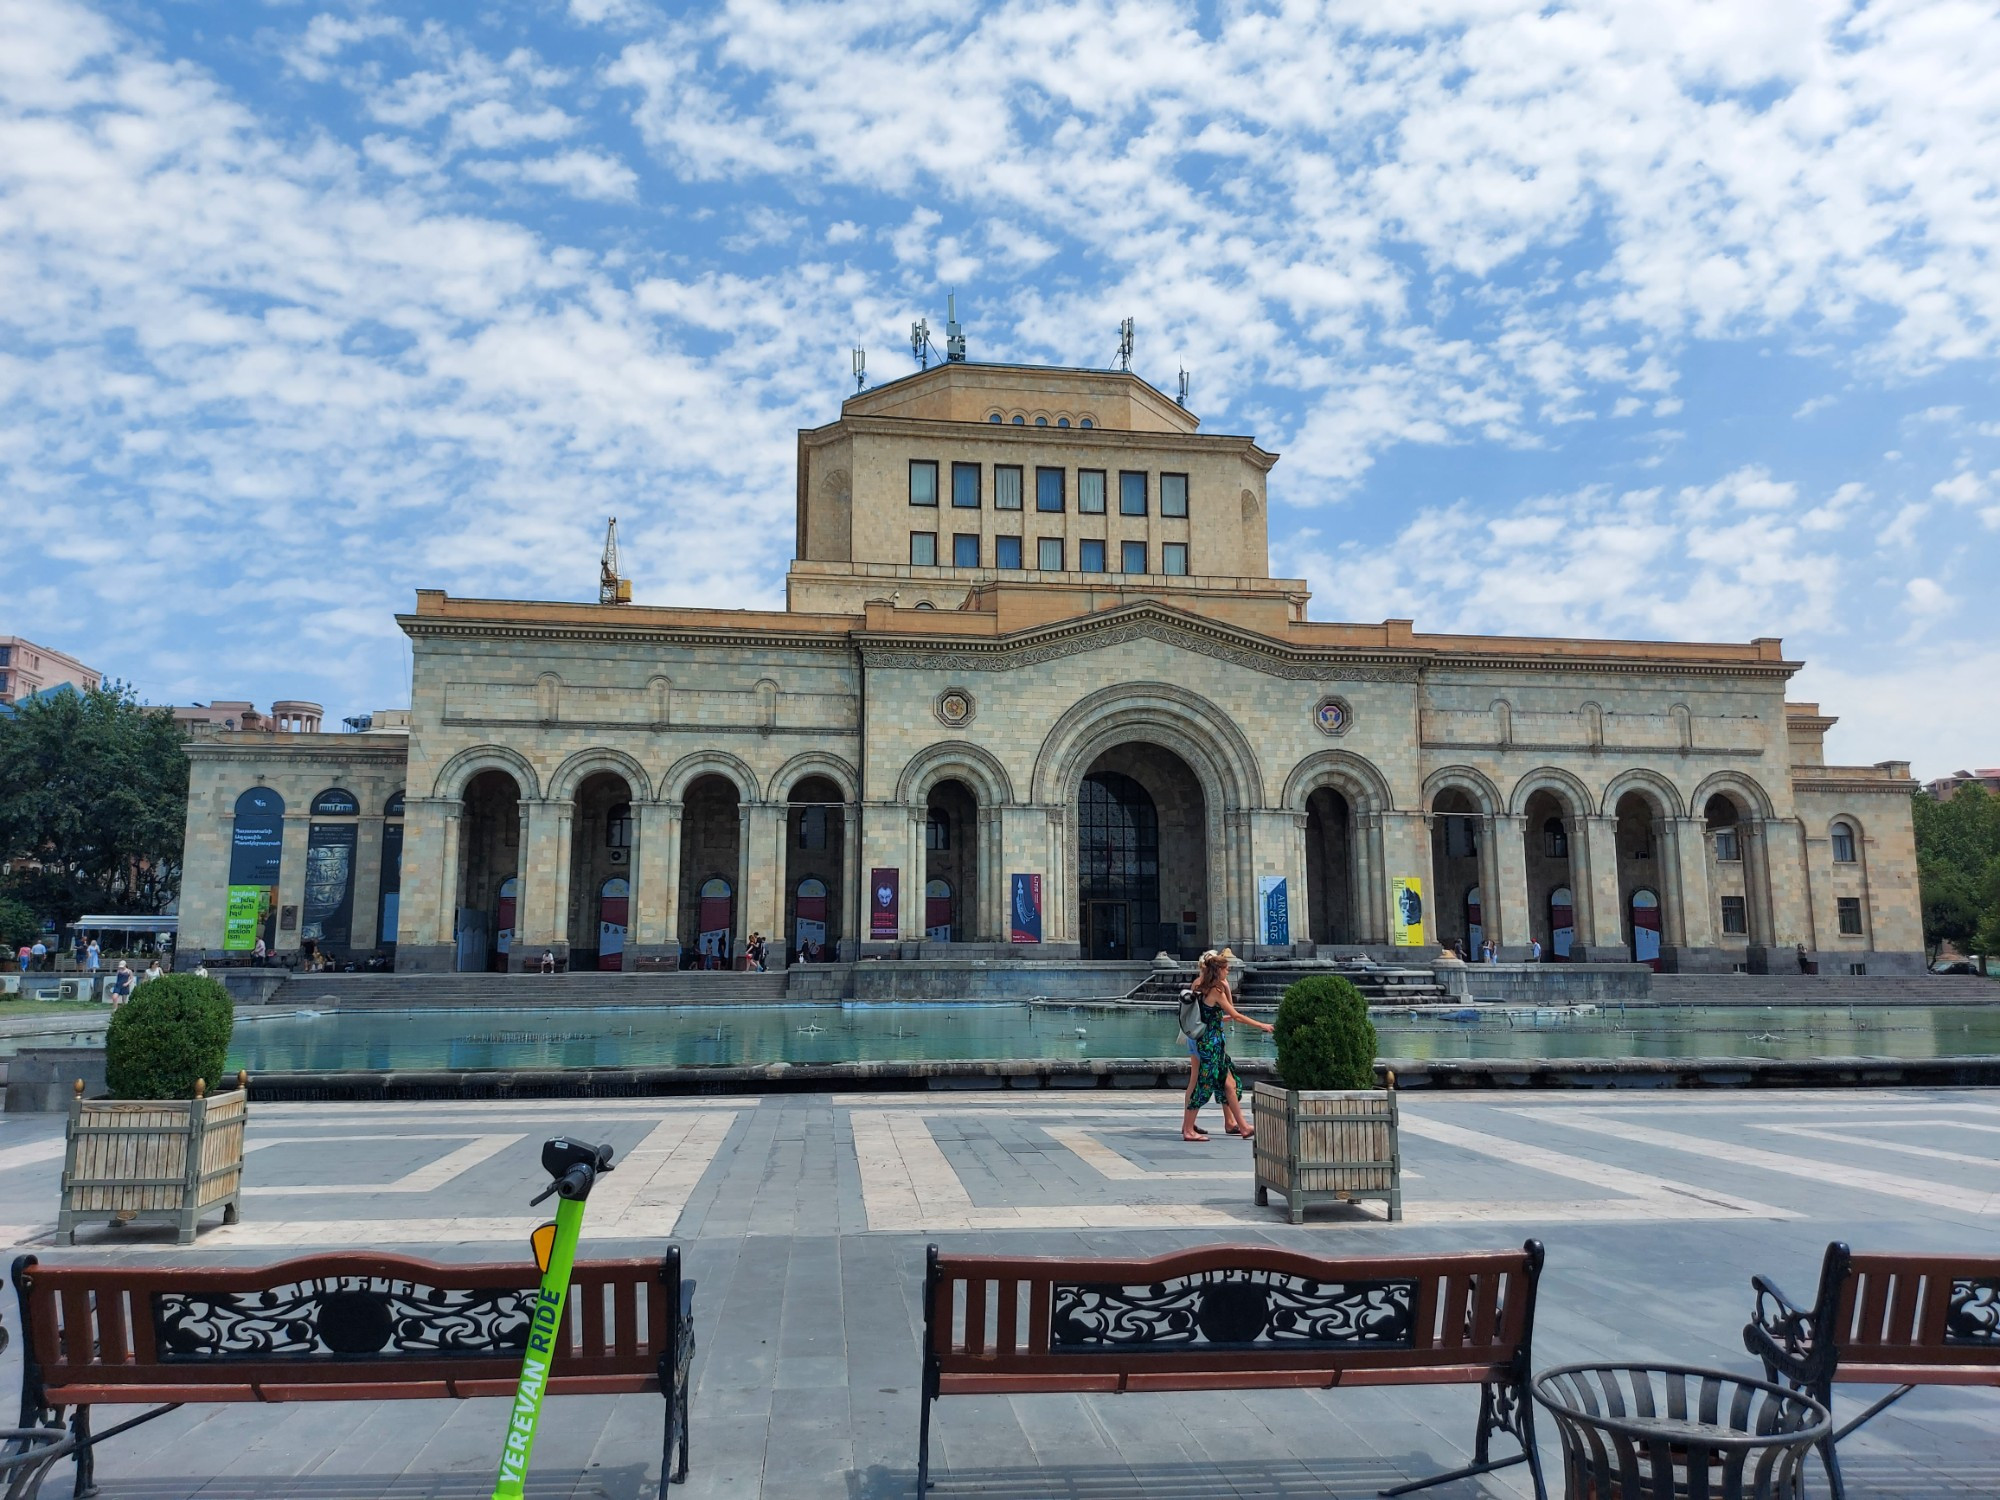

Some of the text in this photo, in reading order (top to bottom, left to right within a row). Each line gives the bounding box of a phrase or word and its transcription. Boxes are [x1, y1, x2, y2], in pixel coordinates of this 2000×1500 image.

[1278, 894, 1287, 922] ARMS
[500, 1286, 561, 1483] YEREVAN RIDE
